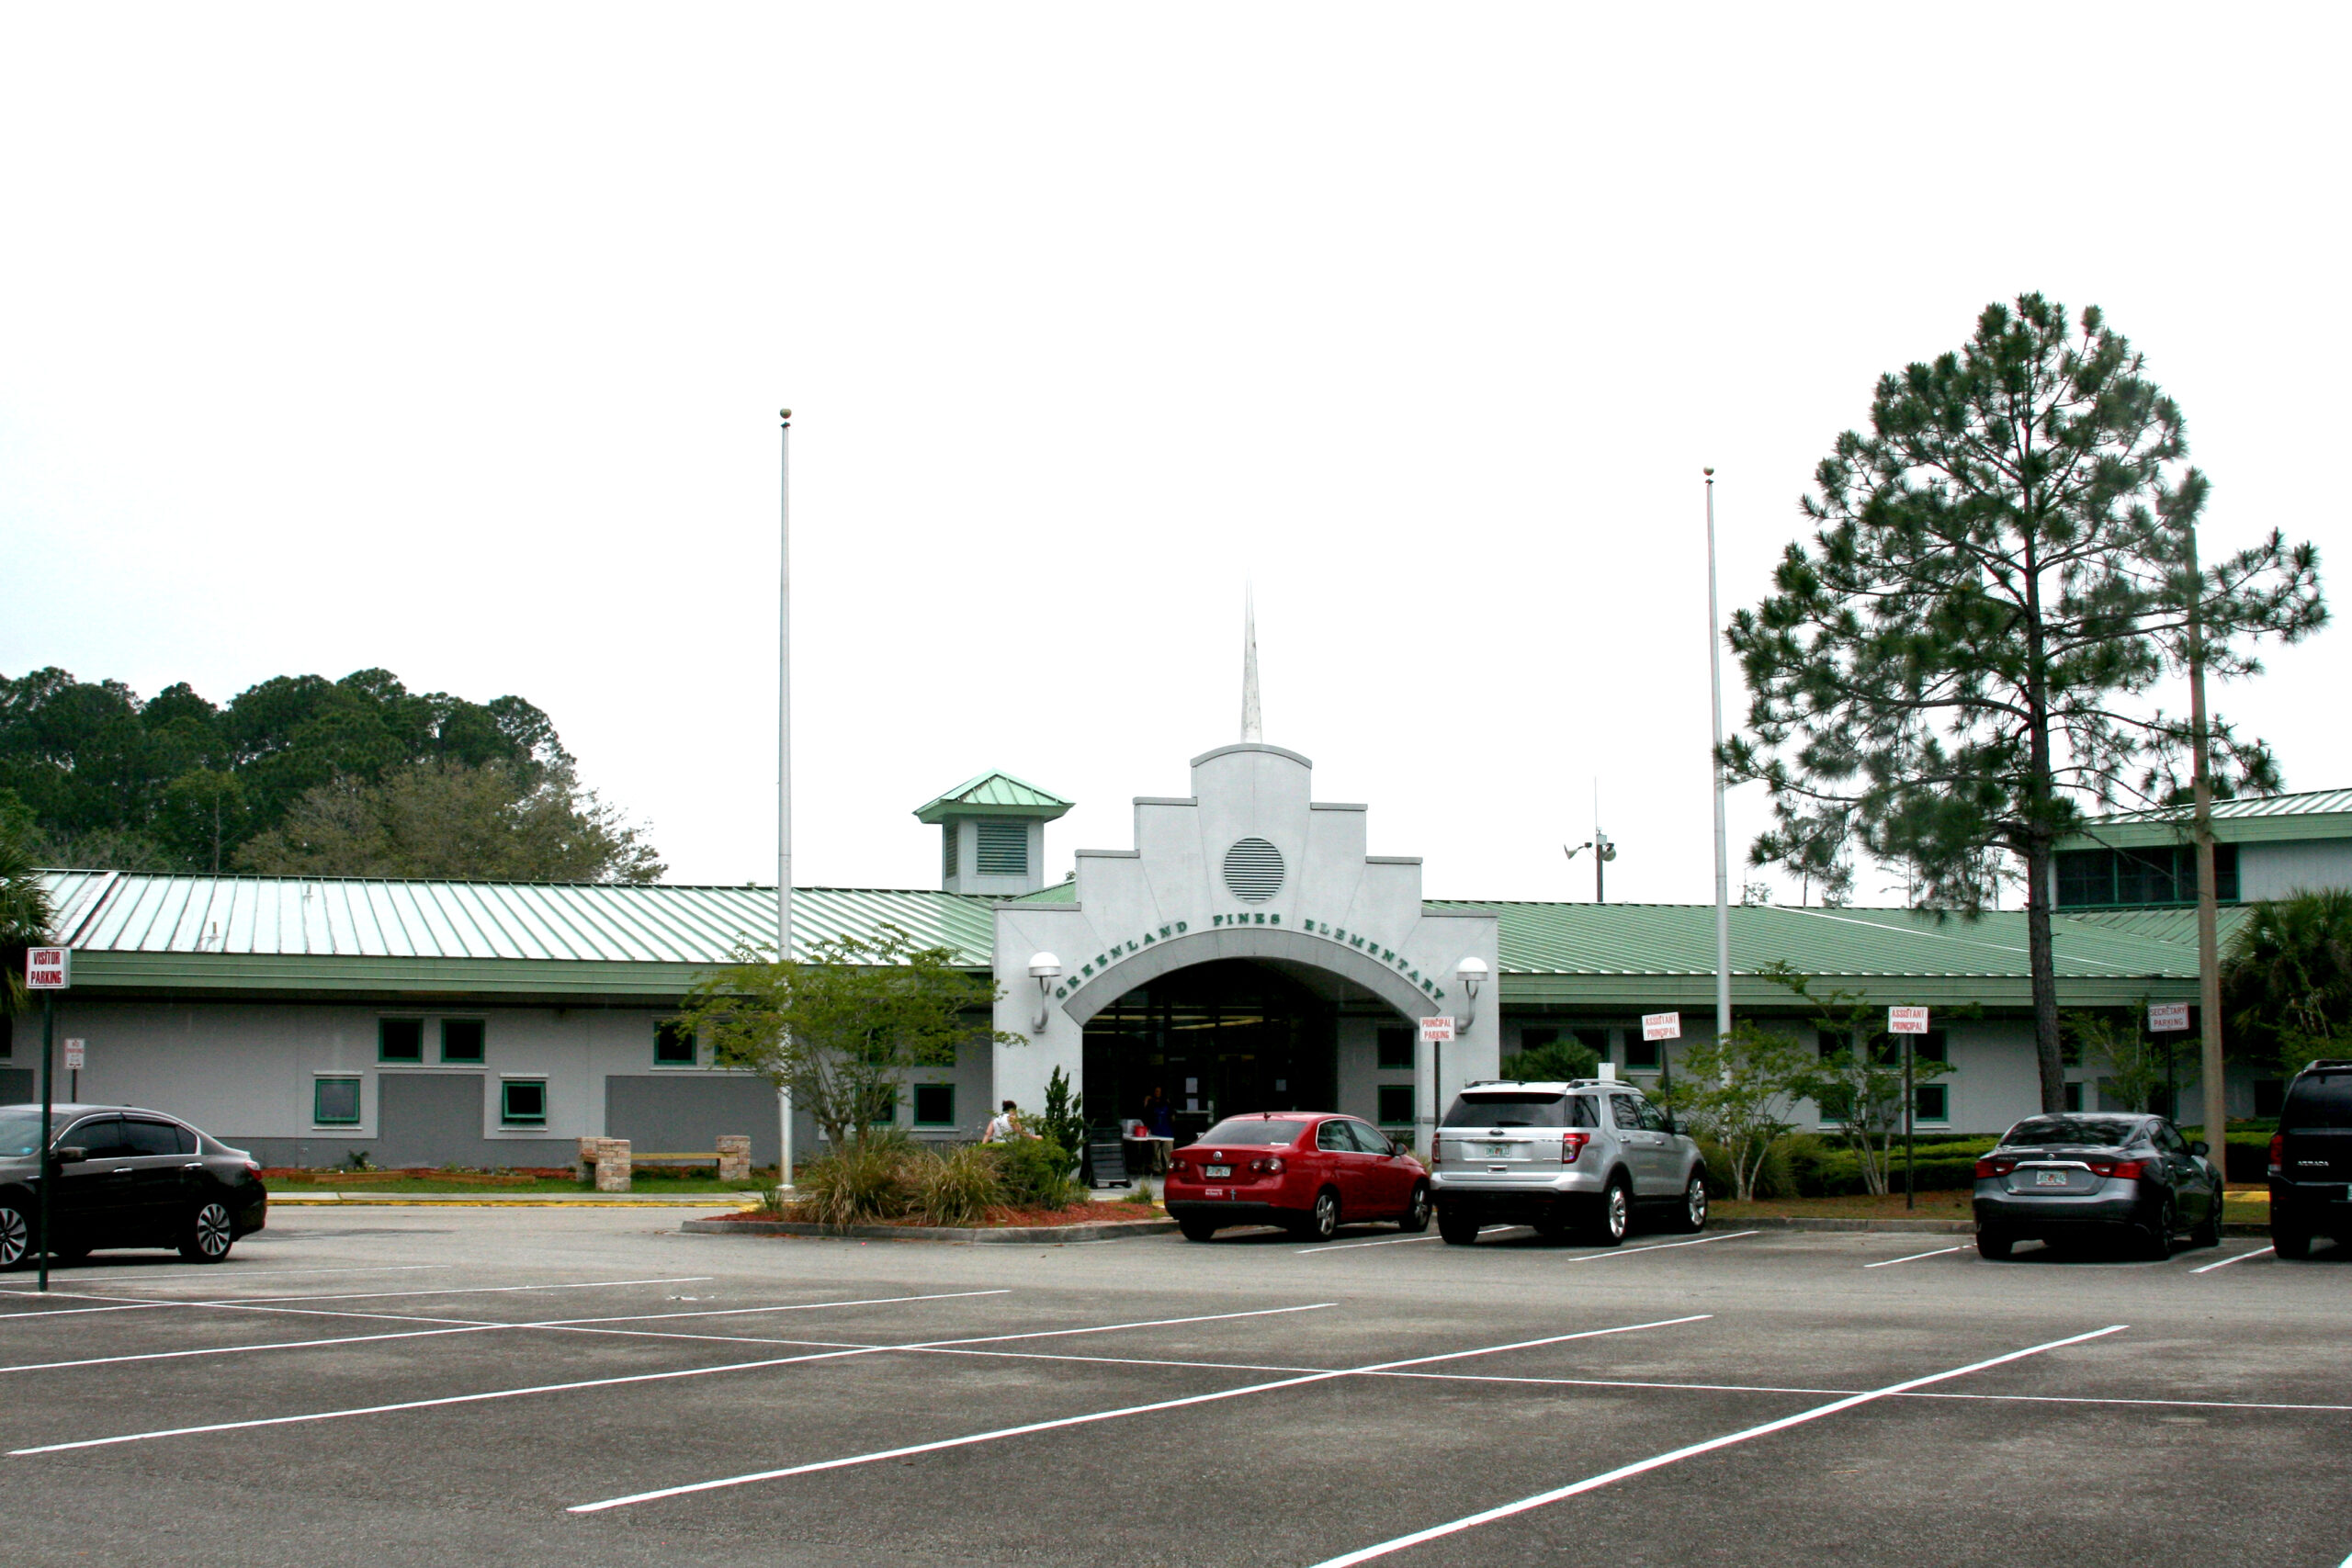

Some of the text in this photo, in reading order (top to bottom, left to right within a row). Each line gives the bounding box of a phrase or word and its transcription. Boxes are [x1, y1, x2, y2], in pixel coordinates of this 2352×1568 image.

[34, 952, 60, 964] VISITOR
[1056, 913, 1445, 1000] GREENLAND PINES ELEMENTARY
[31, 971, 62, 984] PARKING
[1892, 1010, 1924, 1018] ASSISTANT
[2150, 1007, 2185, 1016] SECRETARY
[1422, 1019, 1450, 1027] PRINCIPAL
[1645, 1015, 1676, 1025] ASSISTANT
[2154, 1018, 2184, 1027] PARKING
[1893, 1021, 1922, 1030] PRINCIPAL
[1424, 1031, 1449, 1039] PARKING
[1646, 1027, 1676, 1037] PRINCIPAL
